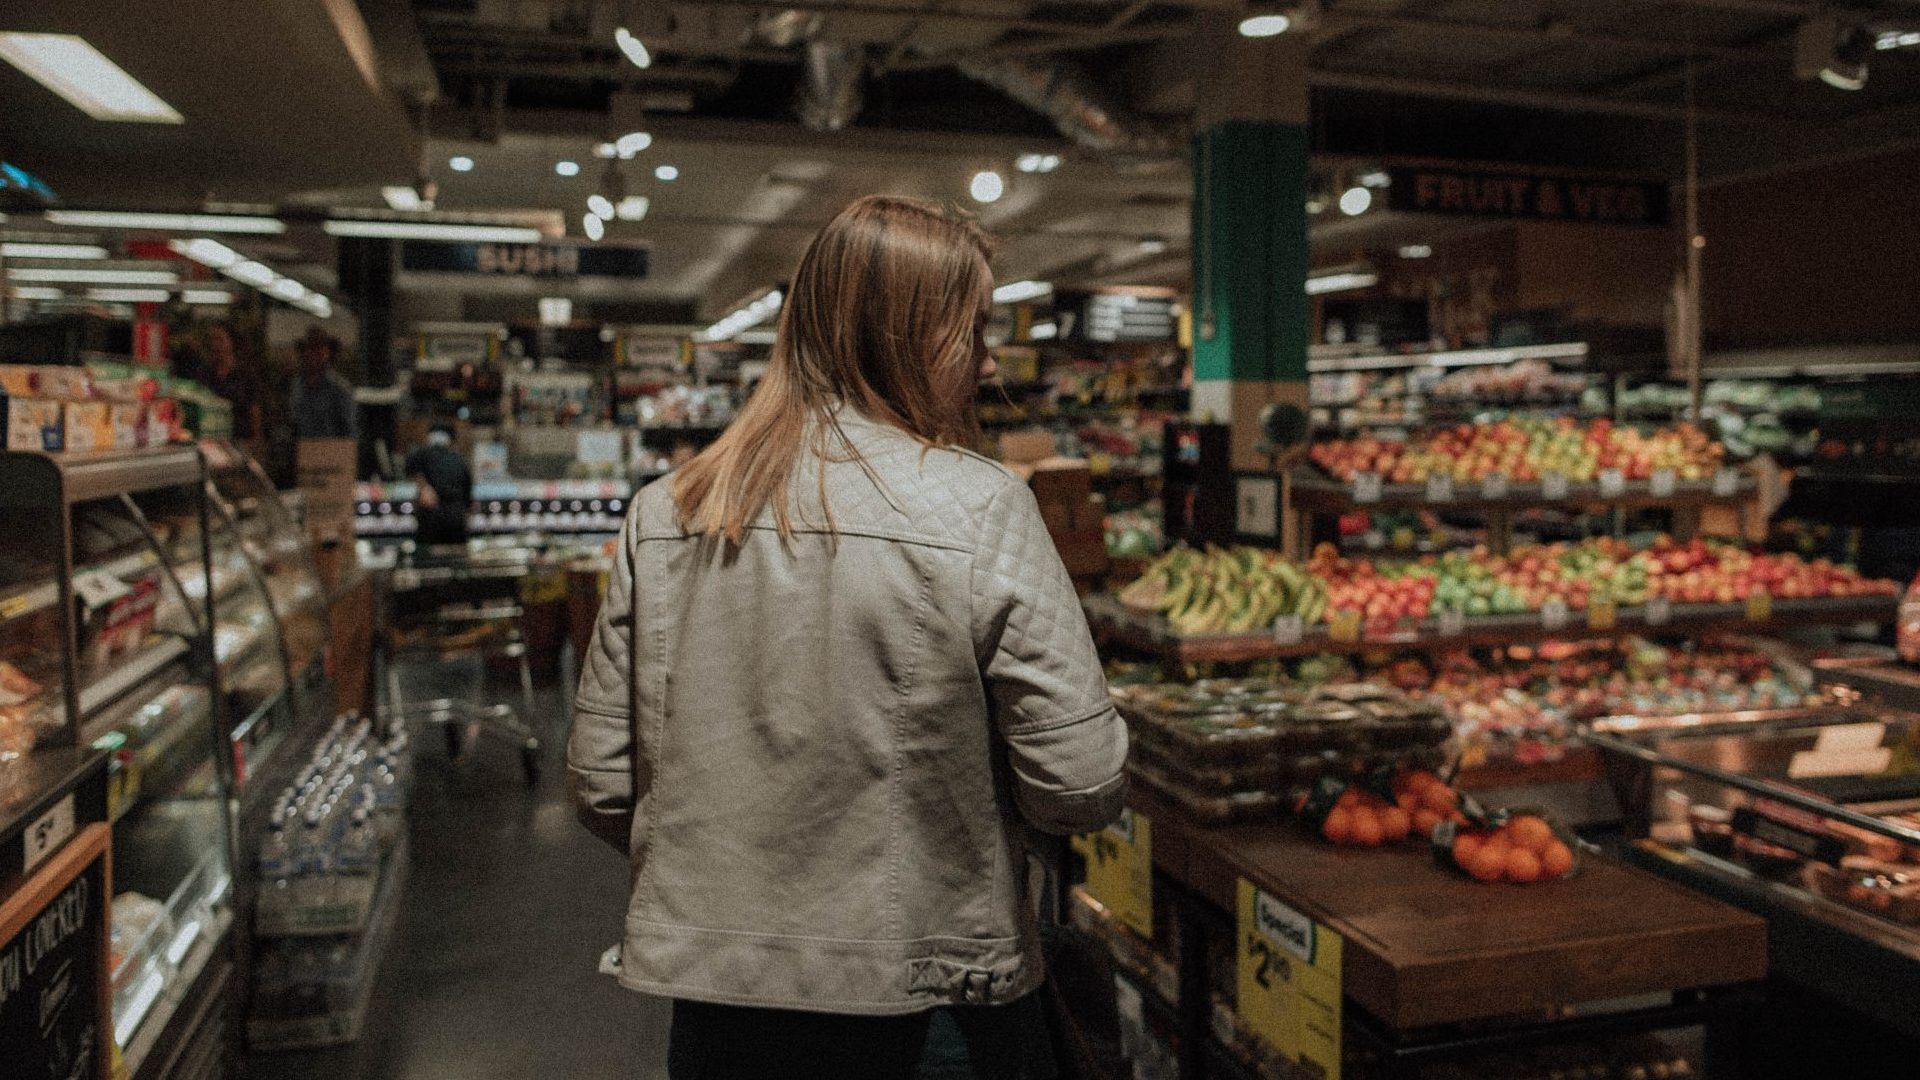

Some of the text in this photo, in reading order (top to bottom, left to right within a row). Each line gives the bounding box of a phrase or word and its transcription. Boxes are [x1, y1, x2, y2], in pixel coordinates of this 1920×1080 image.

[1415, 174, 1651, 219] FRUIT & VEG
[476, 243, 579, 274] SUSHI
[1260, 902, 1306, 947] Special
